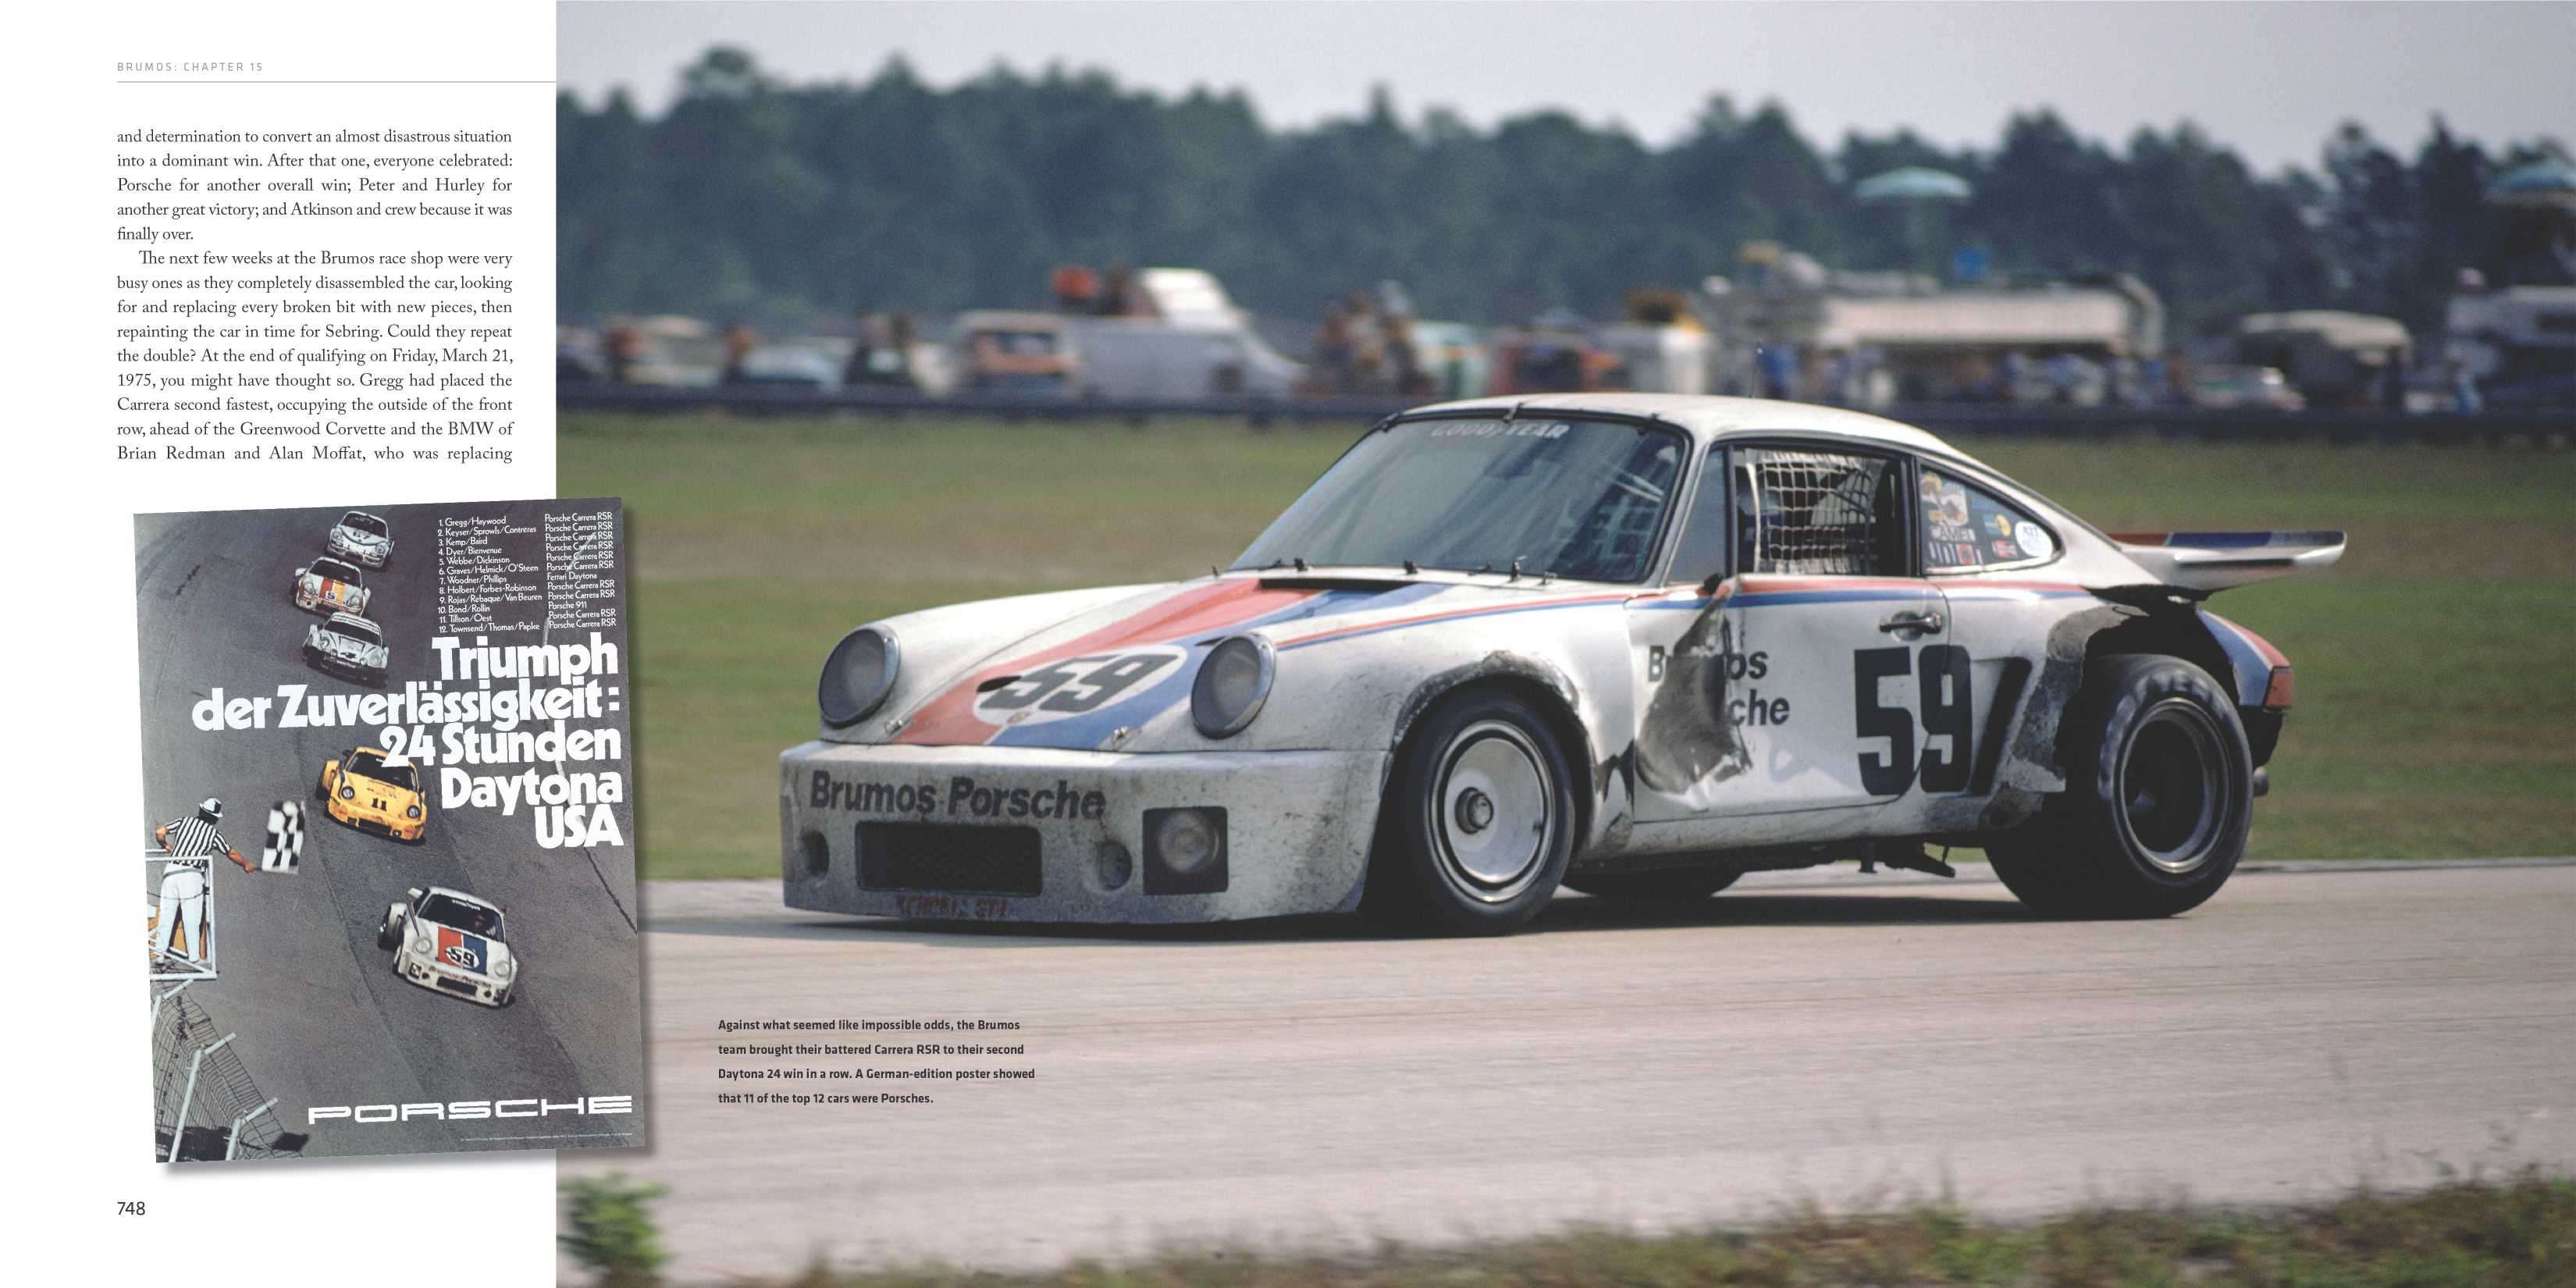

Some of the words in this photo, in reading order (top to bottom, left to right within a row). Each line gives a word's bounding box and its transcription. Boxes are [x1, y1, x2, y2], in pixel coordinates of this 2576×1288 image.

[118, 62, 176, 71] BRUMOS:
[184, 62, 244, 71] CHAPTER
[117, 129, 142, 142] and
[145, 129, 240, 142] determination
[244, 133, 258, 142] to
[262, 133, 312, 142] convert
[335, 130, 380, 142] almost
[383, 129, 450, 142] disastrous
[454, 130, 511, 142] situation
[117, 155, 144, 166] into
[162, 153, 229, 166] dominant
[233, 155, 262, 166] win.
[267, 153, 304, 166] After
[308, 154, 336, 166] that
[341, 158, 369, 169] one,
[373, 158, 434, 171] everyone
[439, 153, 512, 166] celebrated:
[117, 178, 171, 190] Porsche
[179, 178, 199, 190] for
[207, 178, 261, 190] another
[268, 178, 313, 190] overall
[321, 179, 350, 194] win;
[358, 178, 395, 190] Peter
[402, 178, 428, 190] and
[435, 178, 485, 195] Hurley
[492, 178, 512, 190] for
[117, 202, 169, 215] another
[171, 206, 205, 219] great
[208, 203, 258, 219] victory;
[262, 202, 287, 215] and
[290, 202, 353, 215] Atkinson
[356, 202, 381, 215] and
[419, 202, 471, 215] because
[474, 203, 484, 215] it
[116, 226, 158, 244] finally
[138, 251, 165, 264] The
[169, 254, 199, 264] next
[202, 251, 228, 264] few
[231, 251, 272, 264] weeks
[276, 254, 290, 264] at
[294, 251, 315, 264] the
[321, 251, 374, 264] Brumos
[411, 251, 443, 269] shop
[482, 256, 512, 269] very
[116, 276, 148, 293] busy
[203, 276, 233, 293] they
[237, 276, 311, 293] completely
[315, 276, 404, 288] disassembled
[407, 276, 430, 288] the
[434, 280, 457, 291] car,
[460, 276, 512, 293] looking
[445, 516, 507, 528] Gregg/Haywood
[544, 513, 571, 522] Porsche
[571, 513, 596, 521] Carrera
[597, 511, 613, 521] RSR
[445, 525, 537, 537] Keyser/Sprowls/Contreras
[545, 523, 571, 532] Porsche
[572, 522, 596, 531] Carrera
[597, 521, 614, 530] RSR
[447, 575, 507, 584] Woodner/Phillips
[568, 571, 597, 580] Daytona
[447, 583, 537, 593] Holbert/Forbes-Robinson
[547, 582, 574, 590] Porsche
[575, 581, 599, 589] Carrera
[600, 579, 615, 588] RSR
[548, 591, 574, 600] Porsche
[575, 590, 600, 599] Carrera
[600, 589, 615, 598] RSR
[448, 604, 490, 614] Bond/Rollin
[548, 600, 575, 609] Porsche
[448, 613, 493, 623] Tillson/Oest
[548, 610, 575, 619] Porsche
[575, 610, 600, 618] Carrera
[600, 608, 617, 617] RSR
[431, 632, 619, 685] Triumph
[1648, 646, 1768, 682] Bos
[979, 654, 1179, 712] 59
[192, 687, 272, 731] der
[276, 676, 620, 731] Zuverlässigkeit:
[1854, 645, 1973, 796] 59
[379, 725, 436, 767] 24
[442, 720, 621, 765] Stunden
[440, 767, 624, 816] Daytona
[810, 770, 936, 814] Brumos
[948, 776, 1106, 820] Porsche
[371, 798, 387, 812] 11
[535, 802, 624, 849] USA
[447, 948, 475, 969] 59
[308, 1095, 632, 1125] PORSCHE
[117, 1201, 145, 1215] 748
